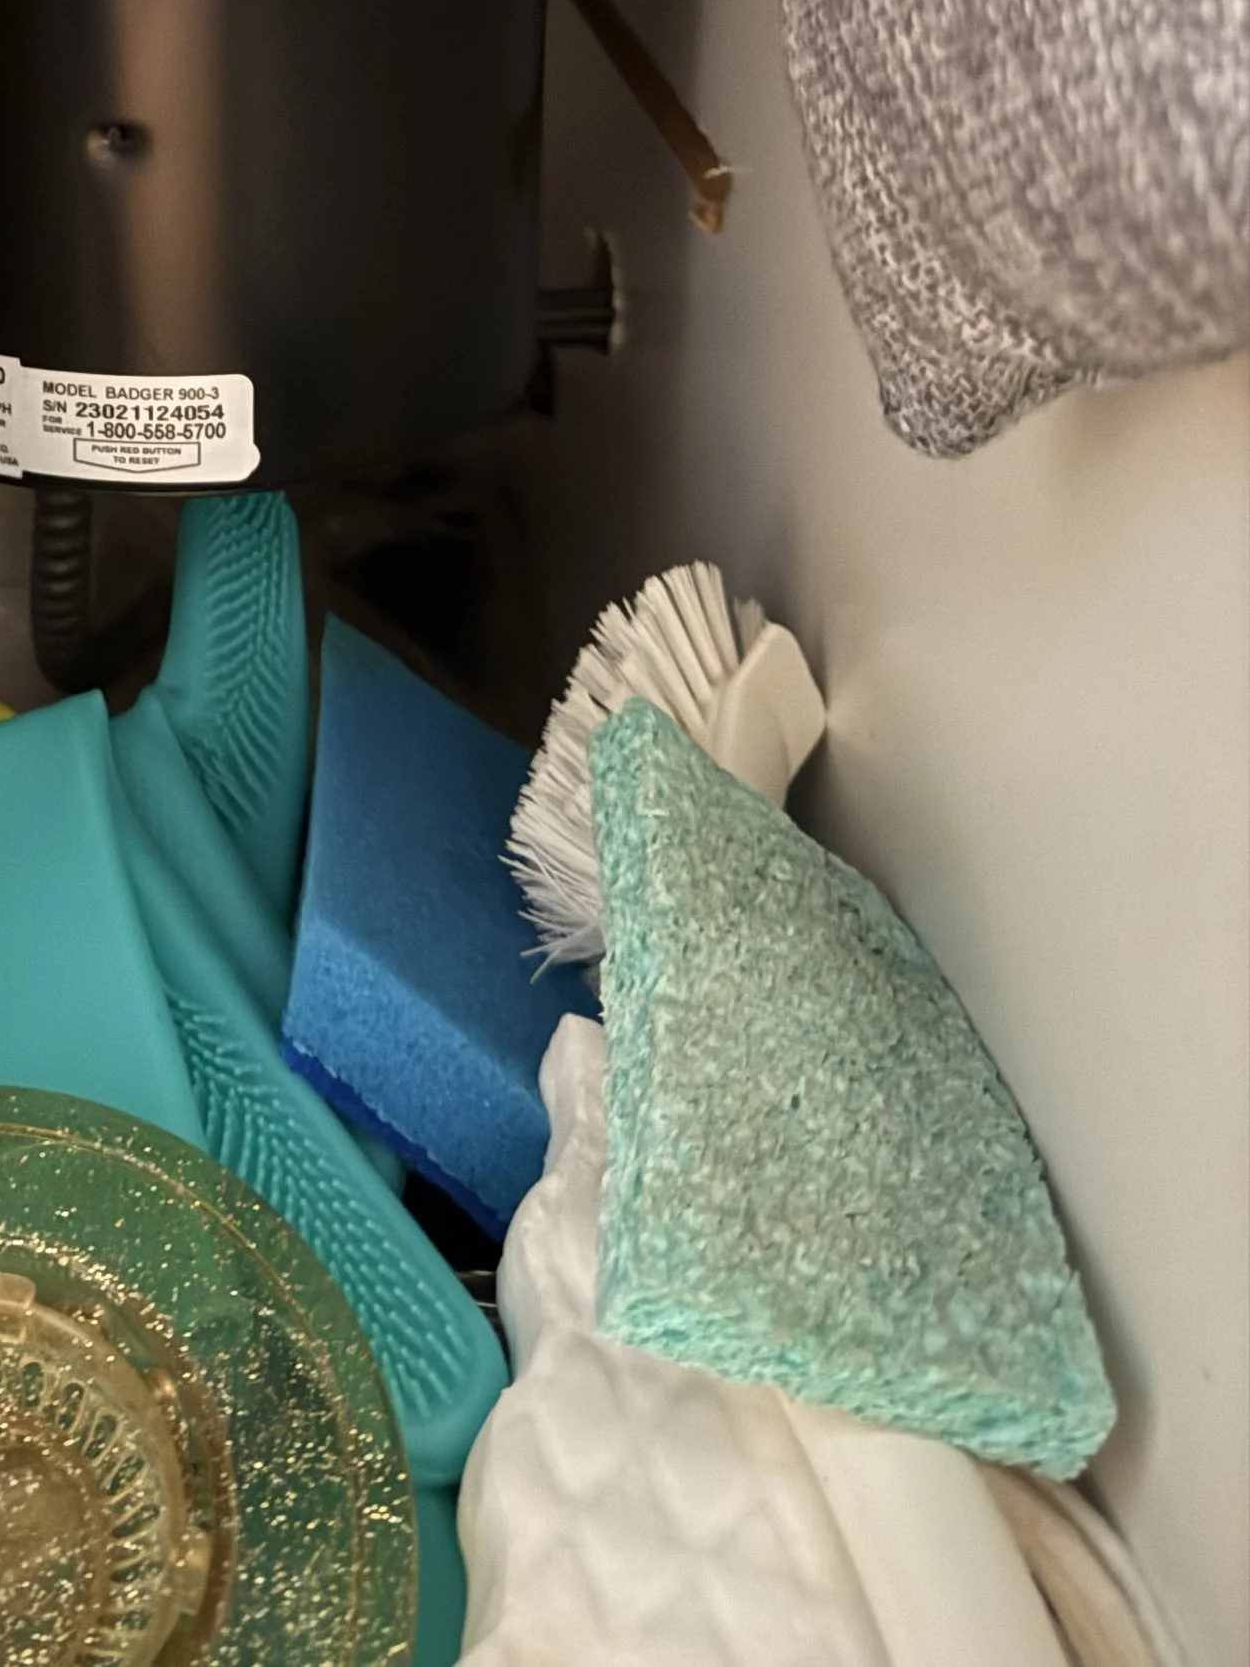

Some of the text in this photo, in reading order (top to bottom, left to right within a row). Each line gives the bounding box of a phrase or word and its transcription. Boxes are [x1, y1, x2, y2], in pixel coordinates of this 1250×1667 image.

[43, 381, 219, 401] MODEL BADGER 900-3
[43, 400, 224, 421] S/N 23021124054
[87, 421, 226, 440] 1-800-558-5700
[91, 445, 182, 455] PUSH RED BUTTON
[113, 456, 160, 465] TO RESET
